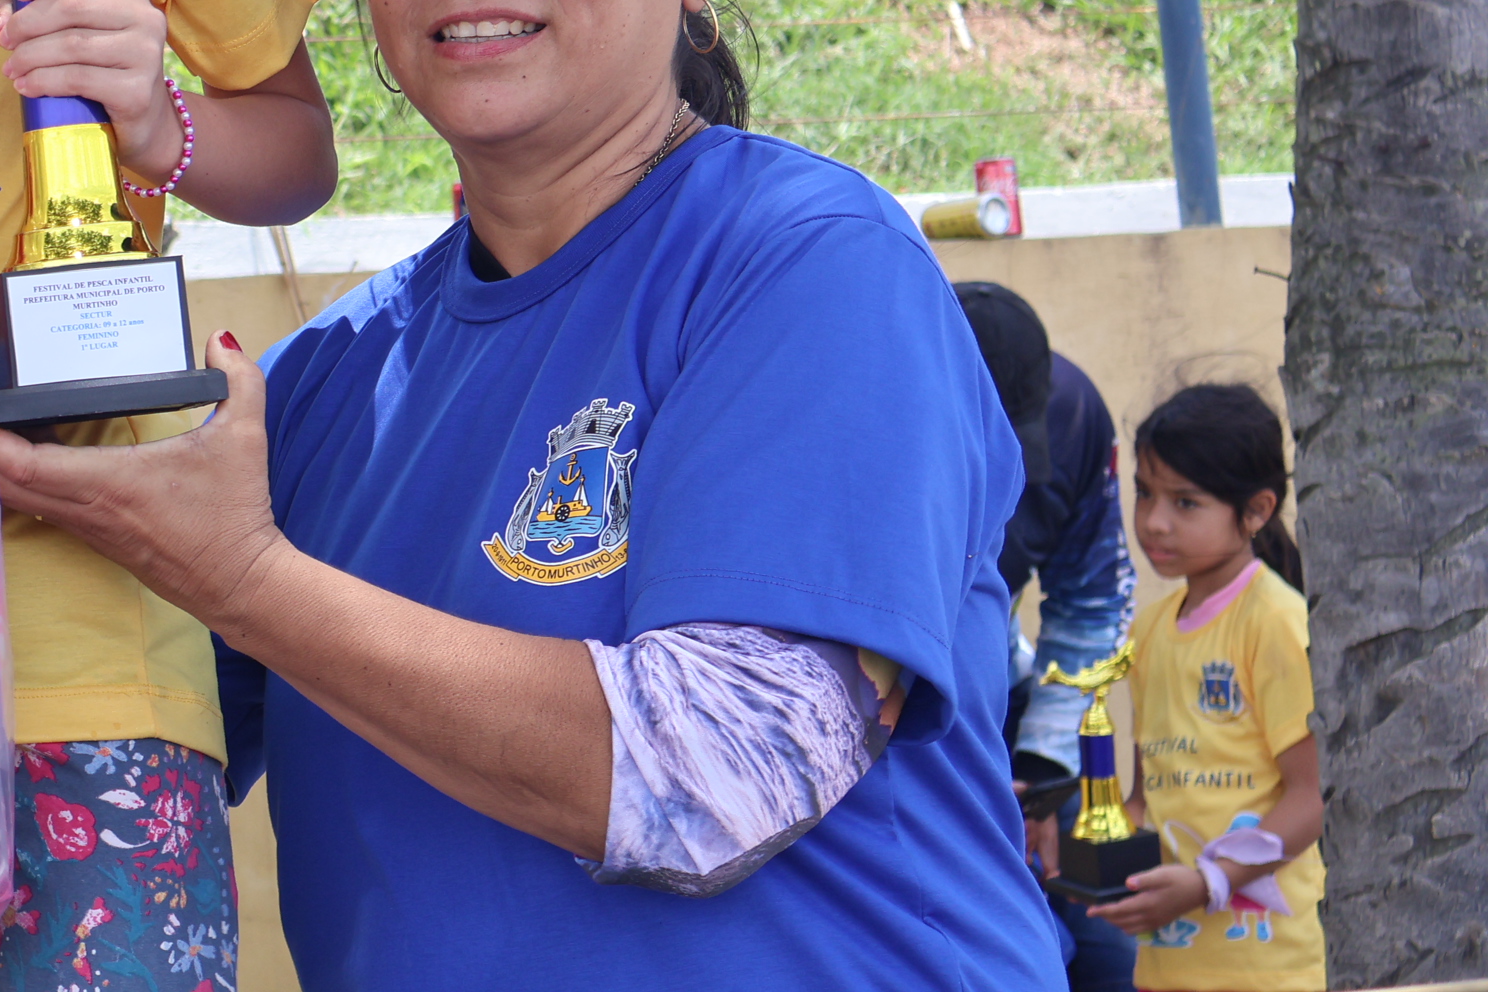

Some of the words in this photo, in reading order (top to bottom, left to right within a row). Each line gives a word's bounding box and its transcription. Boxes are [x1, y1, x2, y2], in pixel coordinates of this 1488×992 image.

[33, 283, 73, 293] FESTIVAL
[74, 281, 86, 290] DE
[87, 279, 113, 288] PESCA
[114, 275, 153, 286] INFANTIL
[23, 293, 75, 304] PREFEITURA
[76, 289, 123, 300] MUNICIPAL
[124, 287, 136, 295] DE
[136, 284, 166, 294] PORTO
[72, 299, 118, 310] MURTINHO
[79, 310, 113, 320] SECTUR
[50, 322, 102, 333] CATEGORIA:
[102, 320, 112, 328] 09
[119, 319, 127, 327] 12
[77, 330, 119, 341] FEMININO
[89, 341, 119, 351] LUGAR
